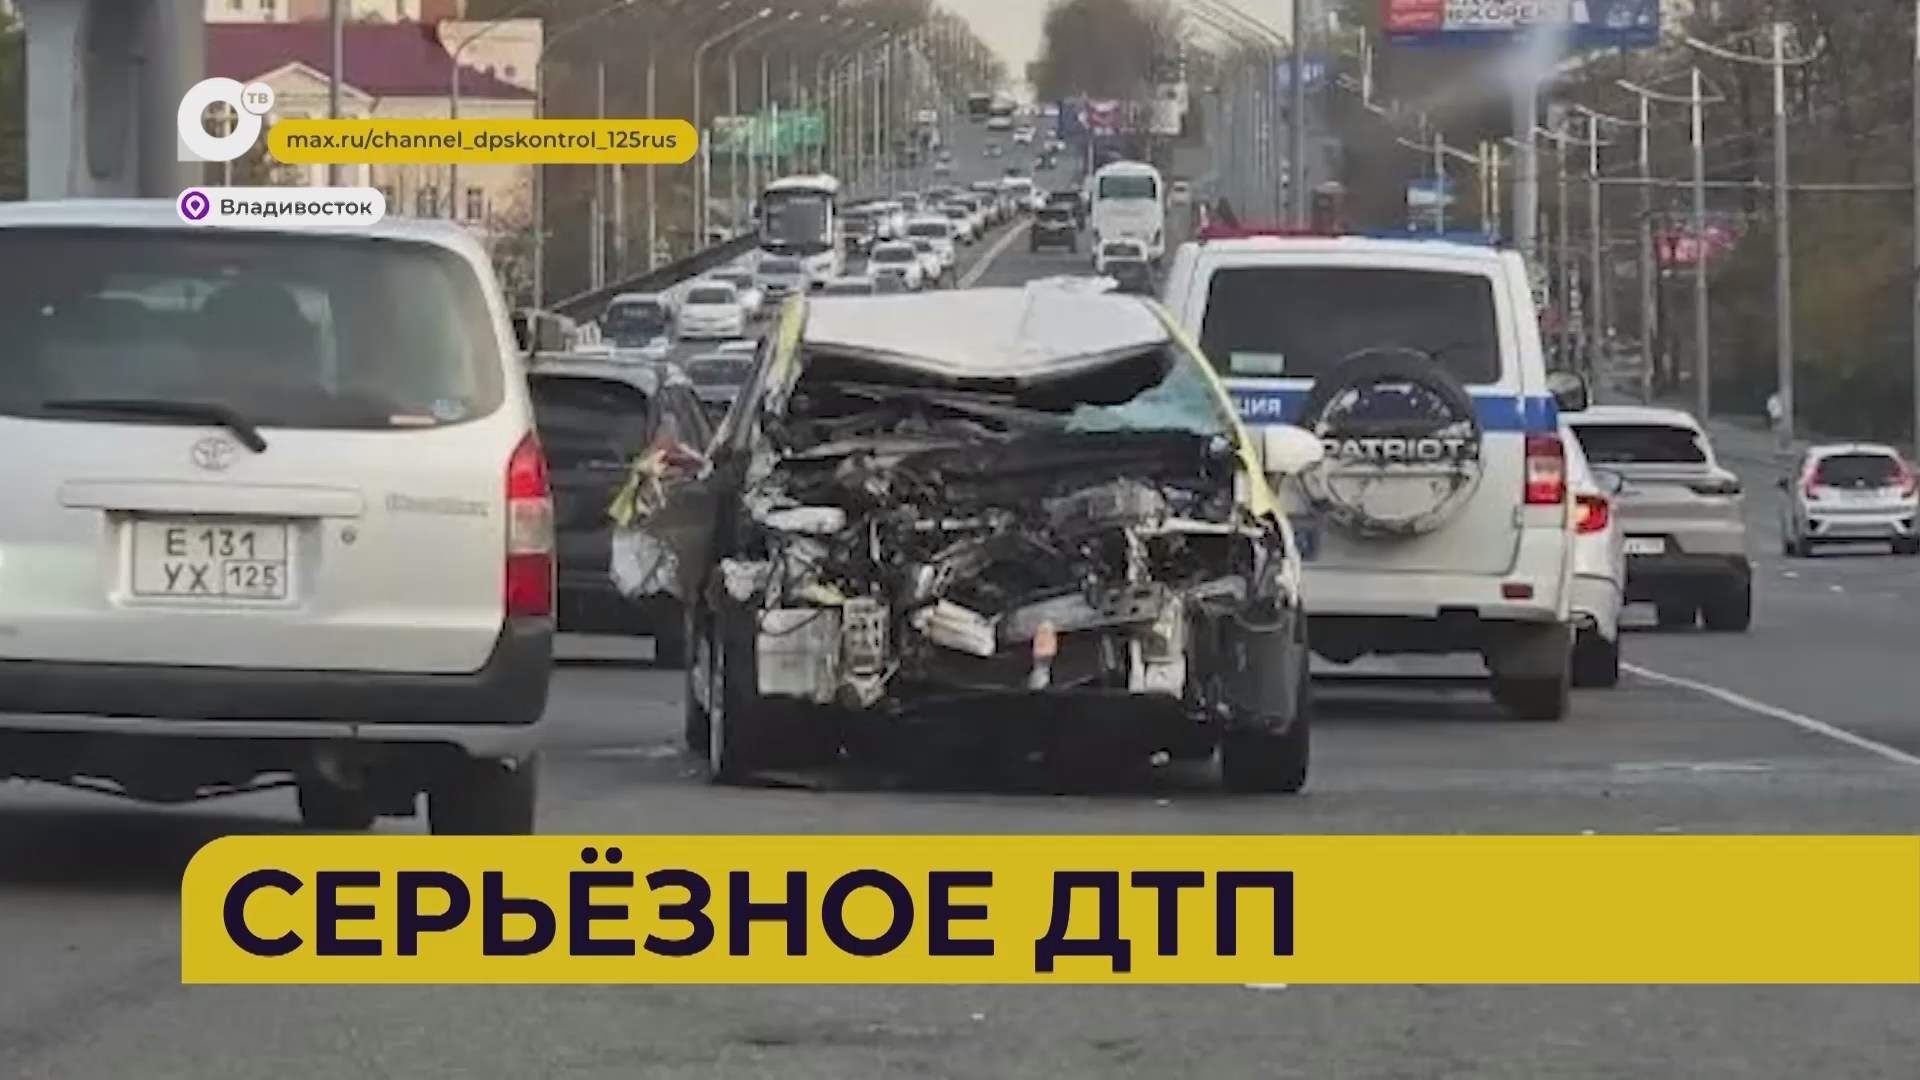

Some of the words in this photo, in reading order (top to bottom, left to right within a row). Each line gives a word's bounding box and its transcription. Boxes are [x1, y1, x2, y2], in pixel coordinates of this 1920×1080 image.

[1233, 397, 1281, 417] ЦИЯ
[1320, 438, 1465, 459] PATRIOT
[166, 528, 188, 557] Е
[199, 528, 255, 560] 131
[163, 562, 210, 591] УХ
[228, 564, 278, 588] 125
